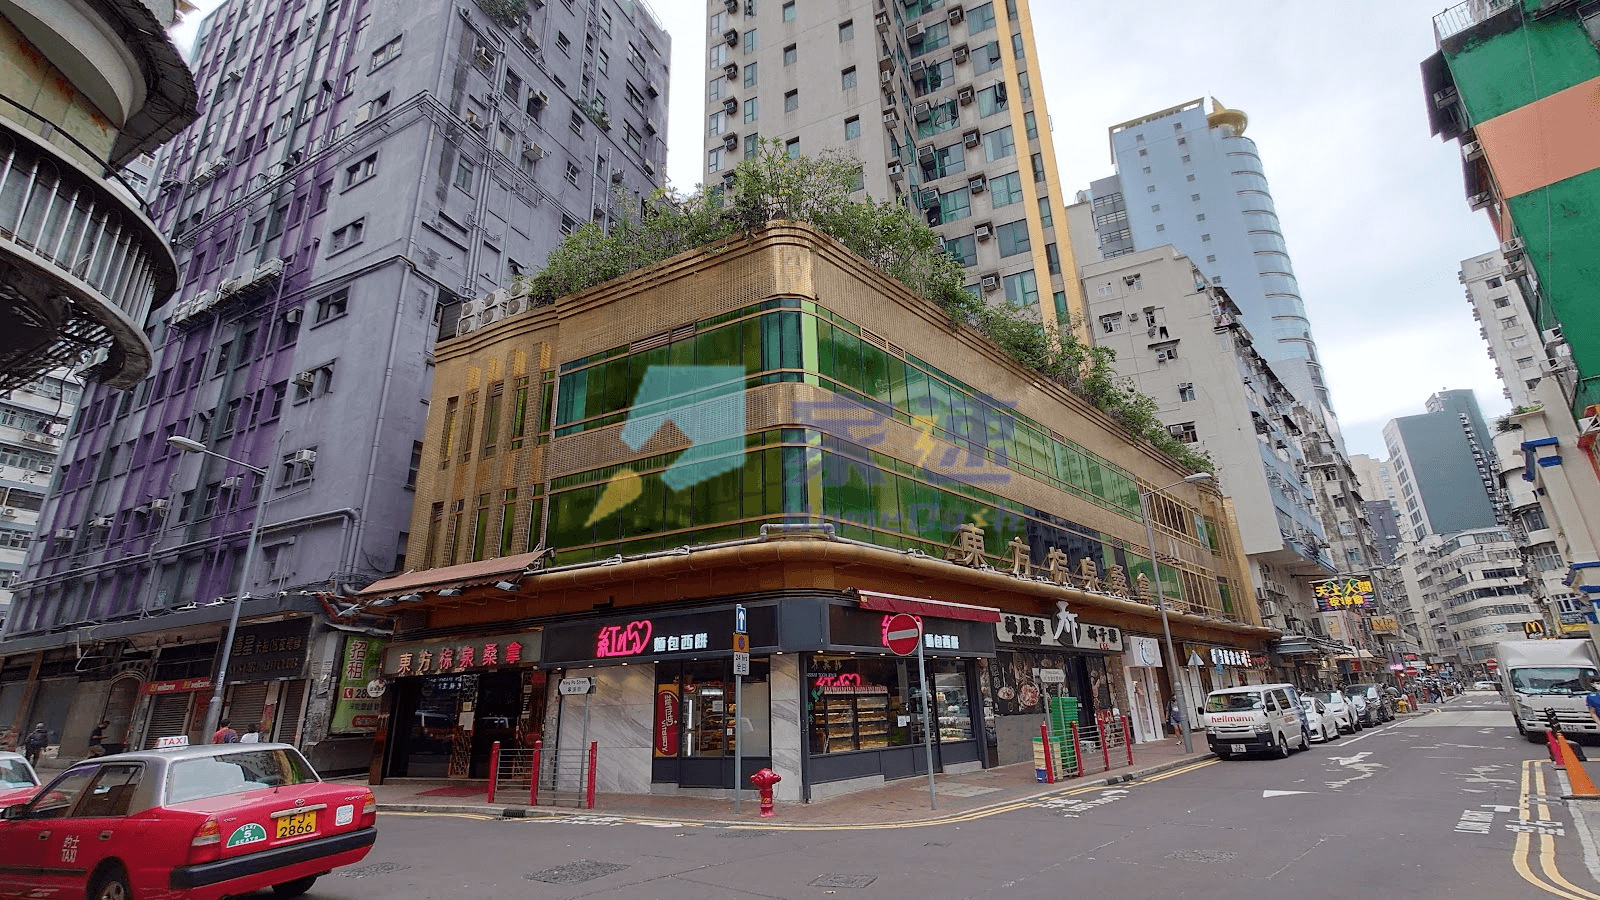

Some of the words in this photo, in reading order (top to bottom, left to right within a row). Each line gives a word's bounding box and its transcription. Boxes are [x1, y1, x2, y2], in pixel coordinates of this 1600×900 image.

[653, 632, 709, 653] 麵包西餅
[924, 633, 960, 649] 麵包西餅
[346, 639, 369, 680] 招租
[397, 641, 523, 675] 東方棕泉桑拿
[1211, 715, 1255, 724] hellmann
[163, 737, 187, 746] TAXI
[288, 814, 307, 825] FJ
[243, 830, 252, 838] 5
[279, 823, 313, 838] 2866
[63, 834, 80, 849] 的士
[235, 835, 259, 844] SEATS
[61, 847, 78, 863] TAXI
